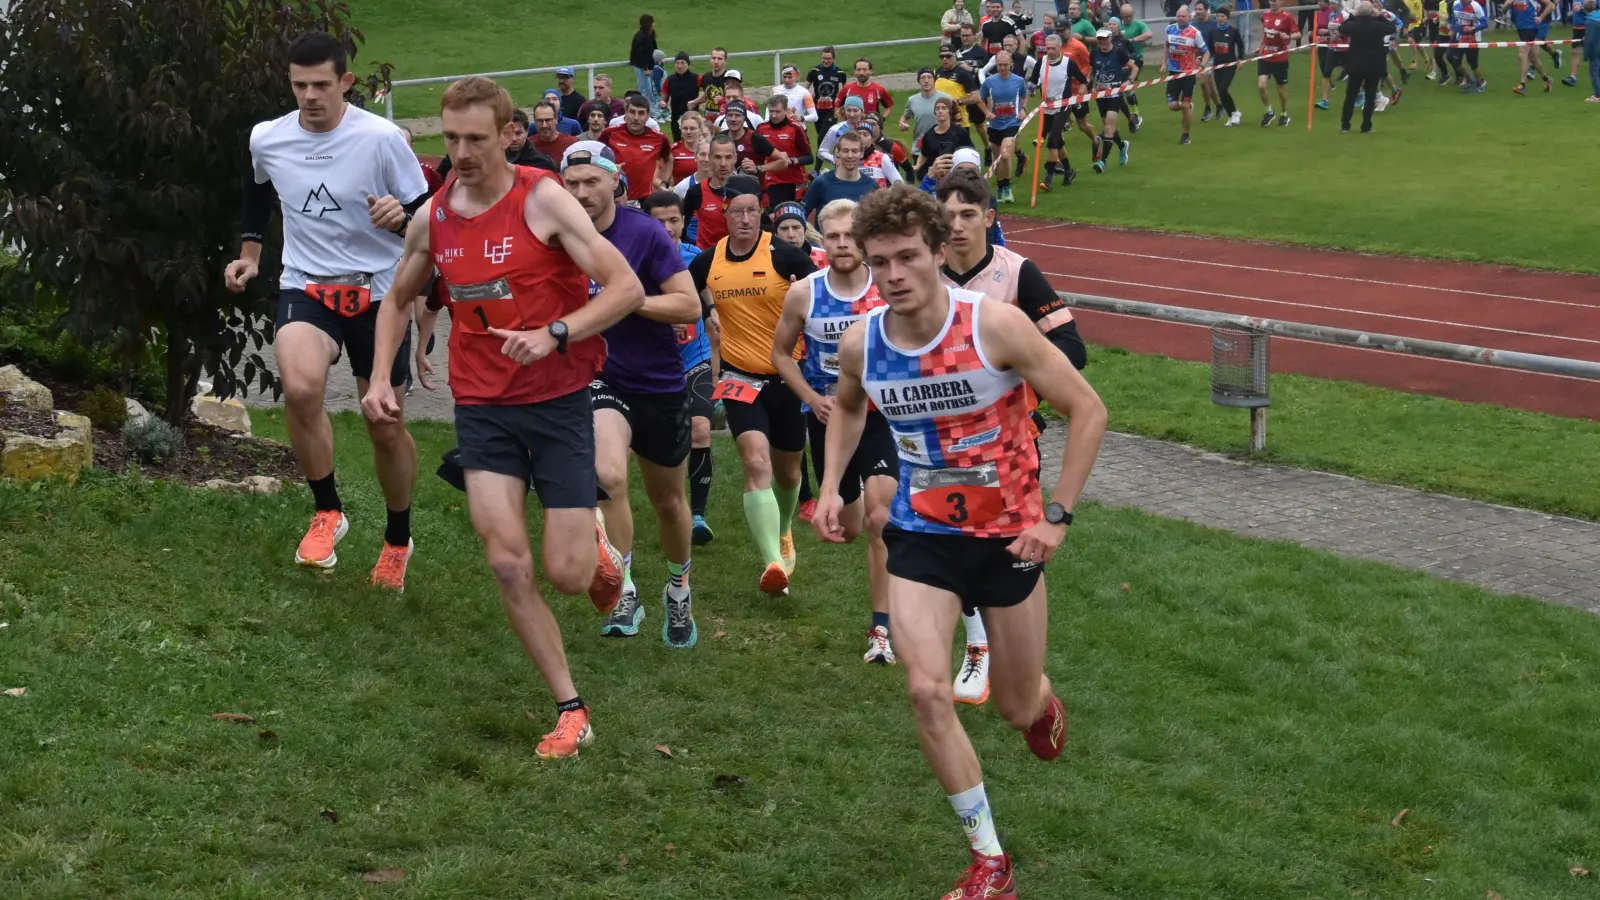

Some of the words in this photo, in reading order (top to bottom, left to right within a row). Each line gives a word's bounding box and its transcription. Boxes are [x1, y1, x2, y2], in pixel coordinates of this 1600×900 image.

[444, 248, 464, 257] HIKE
[715, 287, 768, 300] GERMANY
[473, 305, 489, 329] 1
[824, 321, 837, 333] LA
[721, 383, 745, 397] 21
[880, 388, 898, 405] LA
[902, 379, 974, 402] CARRERA
[883, 403, 928, 416] TRITEAM
[930, 395, 978, 411] ROTHSEE
[946, 492, 968, 523] 3
